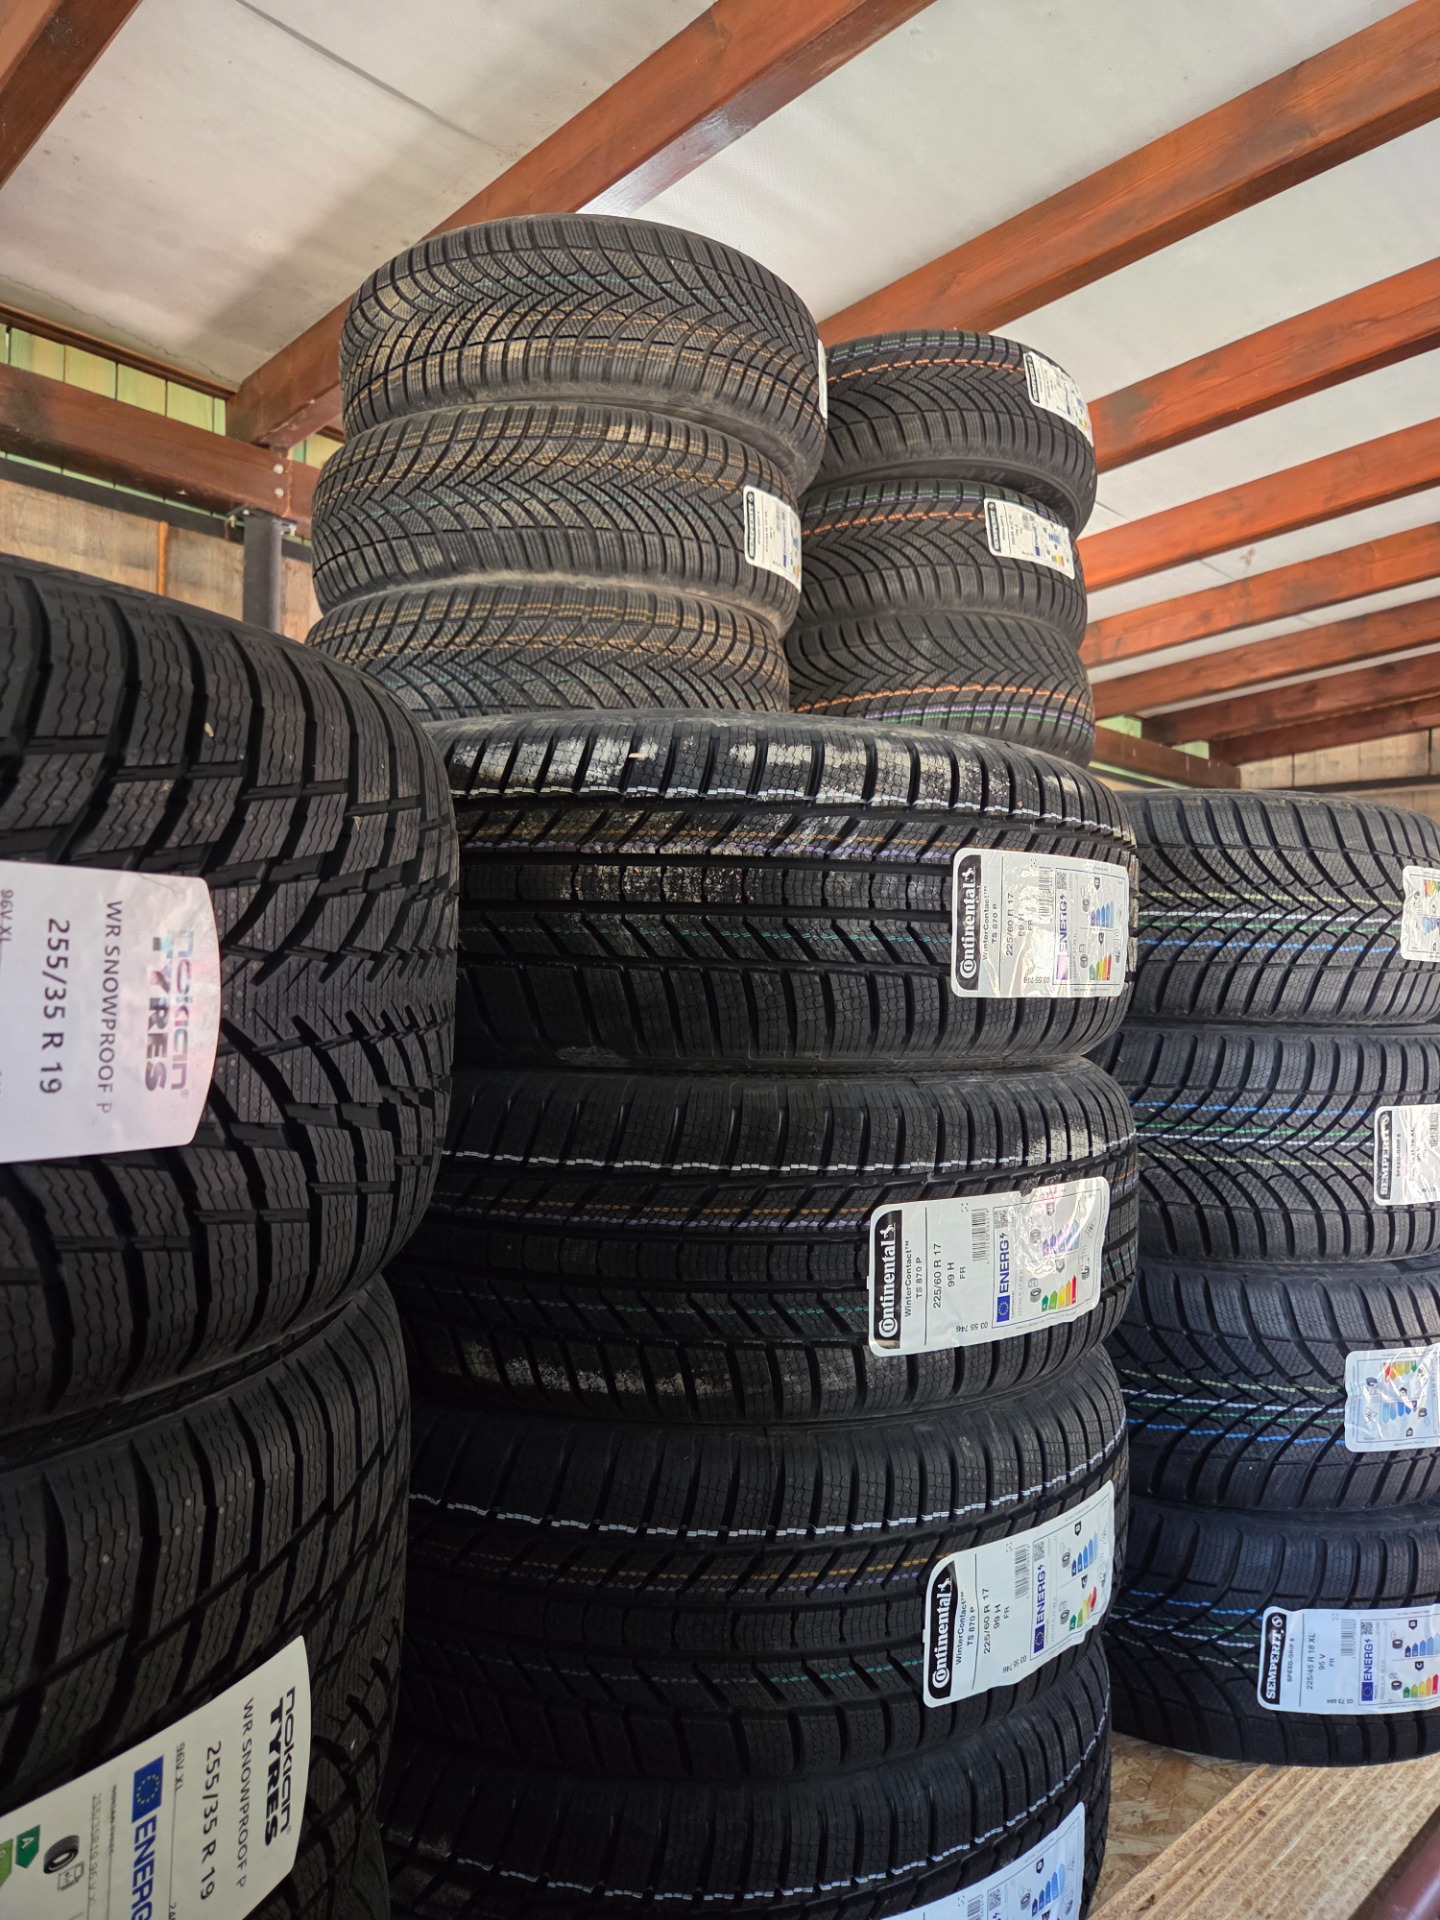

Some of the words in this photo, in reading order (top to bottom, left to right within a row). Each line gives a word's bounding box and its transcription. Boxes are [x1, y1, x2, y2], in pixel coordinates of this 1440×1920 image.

[1007, 892, 1015, 905] 17
[105, 900, 122, 938] WR
[960, 881, 977, 979] Continental
[1006, 919, 1014, 956] 225/60
[42, 918, 70, 1019] 255/35
[98, 945, 121, 1093] SNOWPROOF
[145, 937, 175, 1092] TYRES
[42, 1032, 64, 1050] R
[40, 1062, 62, 1094] 19
[96, 1102, 112, 1114] P
[915, 1257, 922, 1265] P
[933, 1243, 942, 1257] 17
[933, 1259, 942, 1267] R
[947, 1262, 955, 1270] H
[960, 1266, 966, 1279] FR
[999, 1238, 1010, 1294] ENERG
[878, 1239, 898, 1338] Continental
[915, 1286, 922, 1299] TS
[933, 1268, 942, 1309] 225/60
[947, 1274, 955, 1288] 99
[956, 1324, 968, 1333] 746
[970, 1323, 979, 1331] 55
[981, 1588, 989, 1601] 17
[1036, 1571, 1046, 1624] ENERG
[984, 1604, 990, 1613] R
[994, 1604, 1001, 1612] H
[1004, 1606, 1010, 1620] FR
[983, 1614, 991, 1654] 225/60
[994, 1617, 1000, 1629] 99
[932, 1589, 952, 1689] Continental
[967, 1634, 974, 1646] TS
[1309, 1632, 1316, 1642] XL
[1266, 1630, 1284, 1699] SEMPERIT
[1319, 1660, 1325, 1670] 95
[1363, 1643, 1373, 1681] ENERG
[1306, 1664, 1314, 1690] 225/45
[243, 1696, 255, 1734] WR
[265, 1696, 284, 1847] TYRES
[280, 1686, 296, 1833] nokian
[202, 1740, 222, 1836] 255/35
[236, 1738, 252, 1872] SNOWPROOF
[21, 1836, 34, 1849] A
[202, 1839, 216, 1864] R
[200, 1867, 216, 1901] 19
[236, 1874, 247, 1889] P
